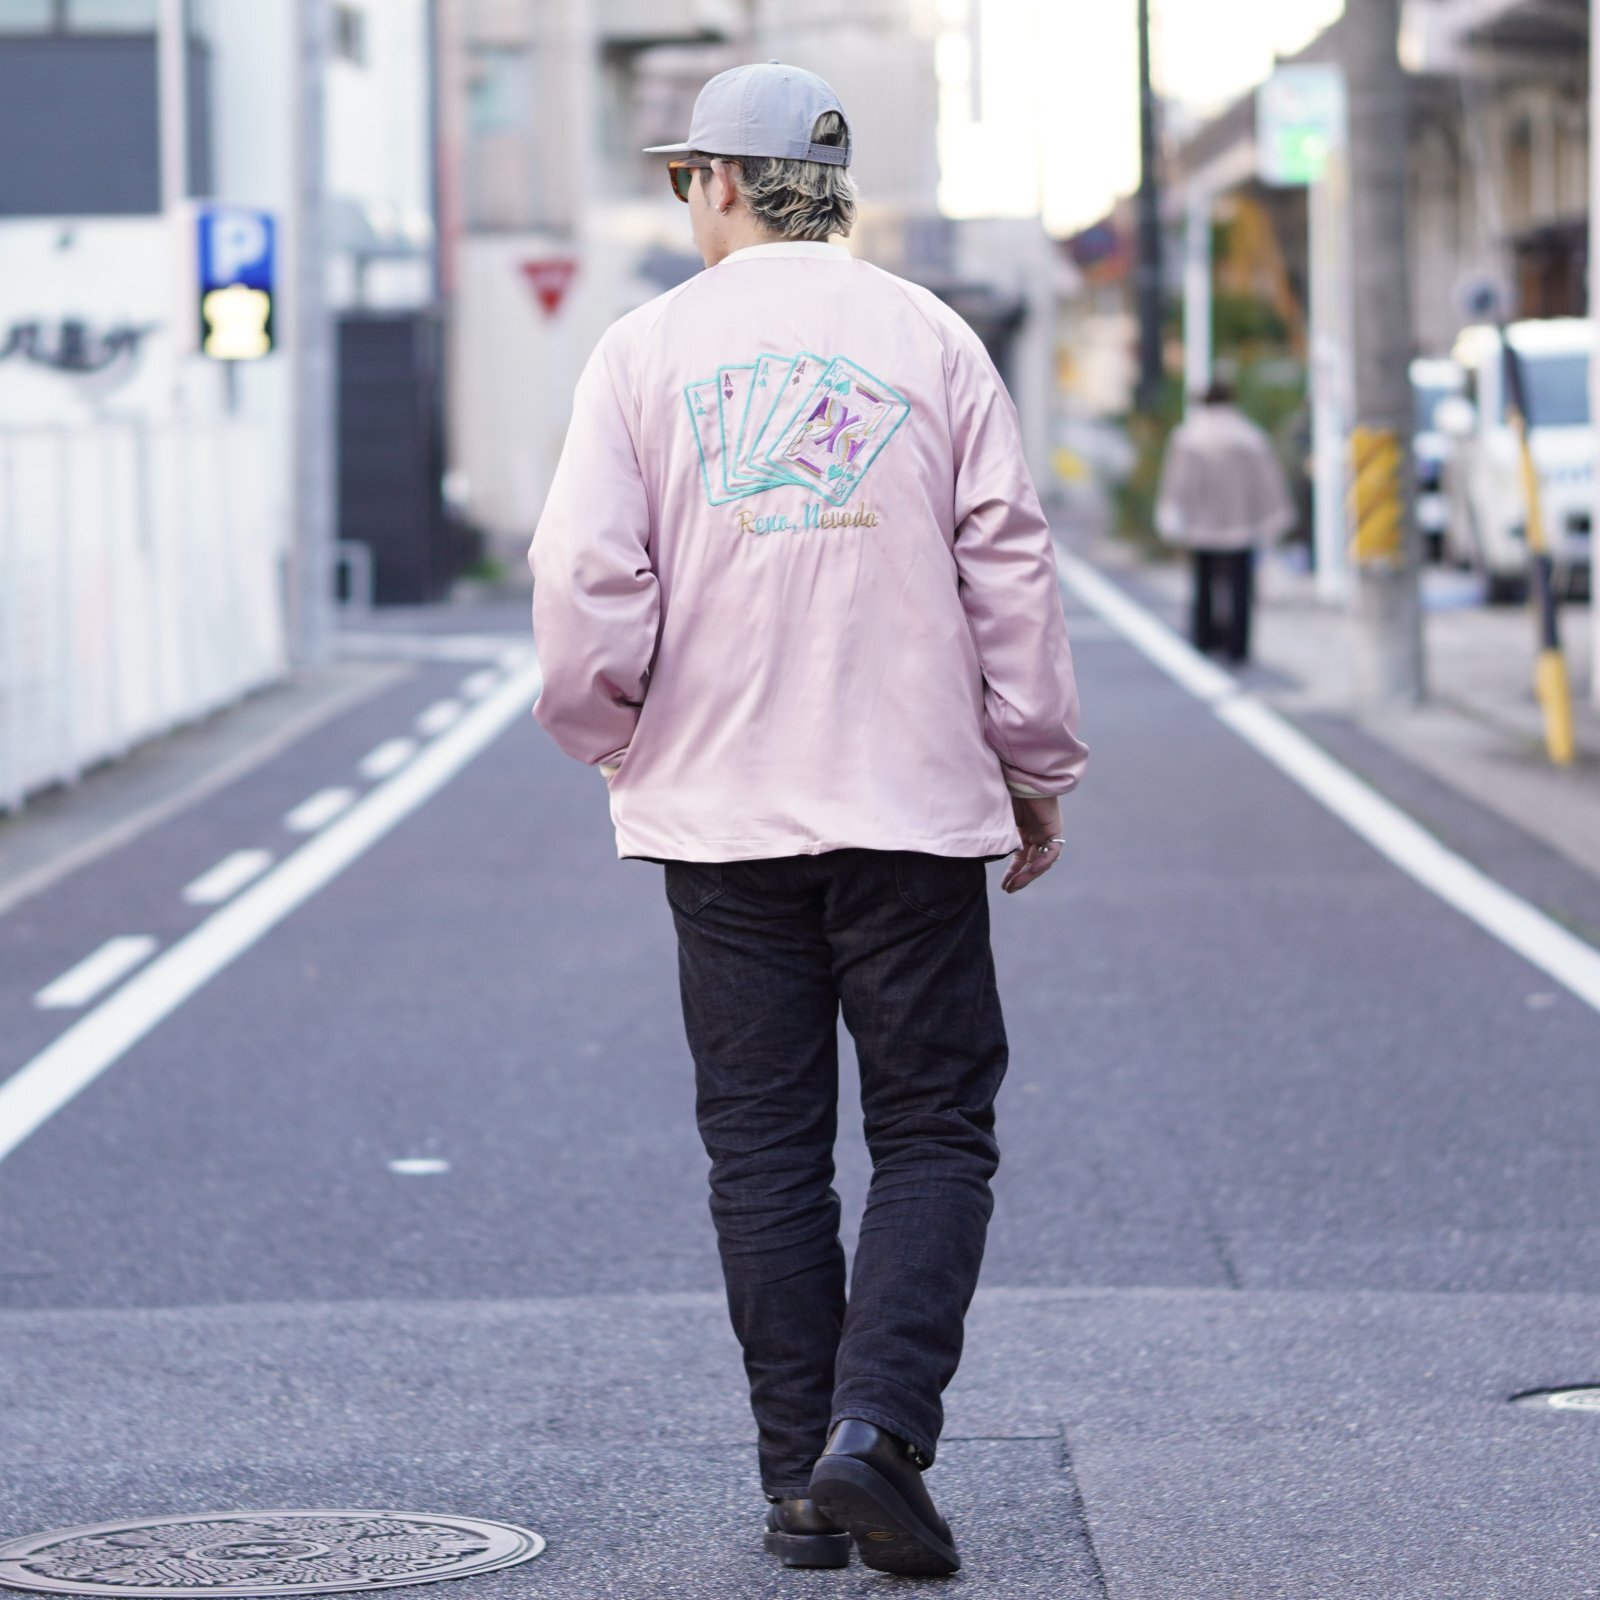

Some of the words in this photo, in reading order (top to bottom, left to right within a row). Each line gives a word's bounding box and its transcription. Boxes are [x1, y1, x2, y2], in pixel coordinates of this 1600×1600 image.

[210, 211, 265, 282] P
[760, 361, 769, 375] A
[795, 359, 806, 374] A
[724, 373, 733, 387] A
[694, 390, 703, 404] A
[737, 509, 798, 535] Reno,
[803, 502, 879, 530] Nevada
